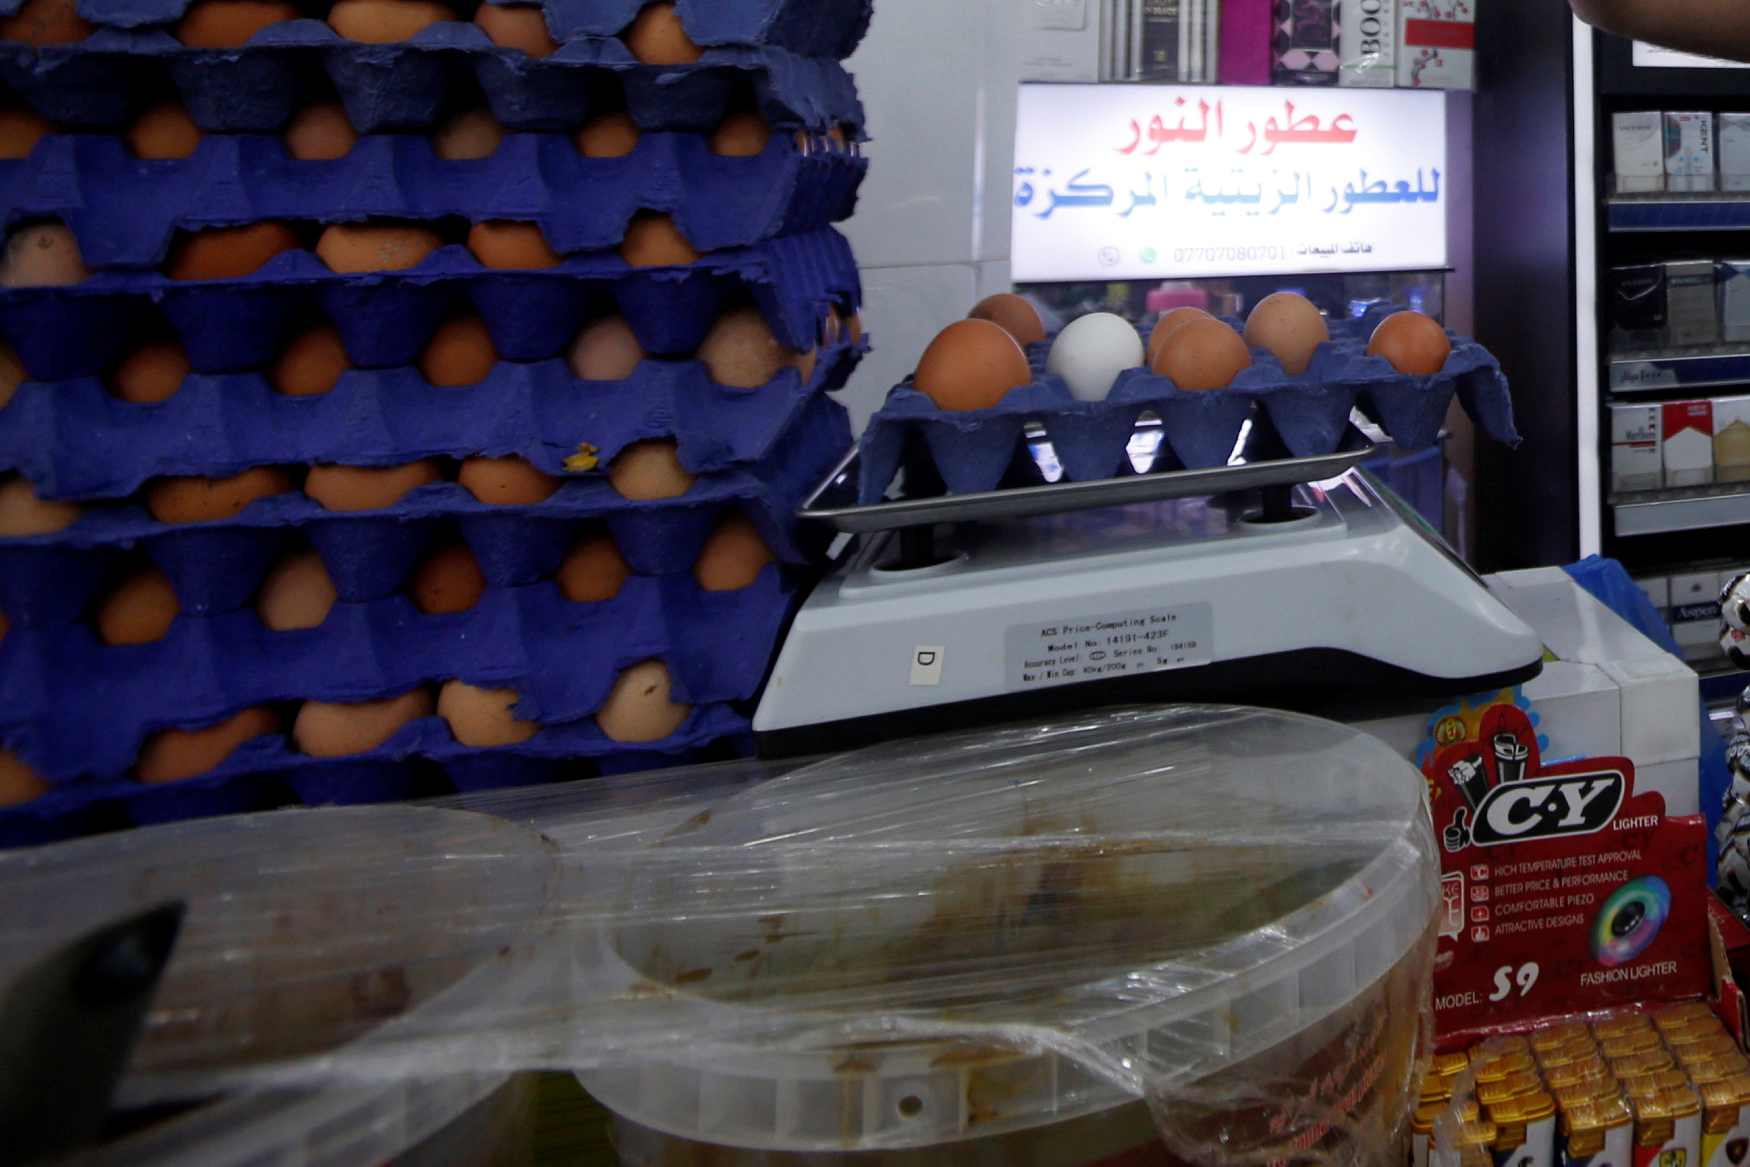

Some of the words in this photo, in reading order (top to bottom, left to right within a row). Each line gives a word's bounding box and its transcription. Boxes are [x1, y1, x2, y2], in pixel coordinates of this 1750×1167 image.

[1114, 97, 1222, 155] النور
[1236, 99, 1358, 155] عطور
[1701, 120, 1709, 154] KENT
[1013, 166, 1168, 220] المركزة
[1184, 167, 1312, 216] الزيتية
[1321, 168, 1440, 214] للعطور
[1174, 244, 1286, 263] 07707080701
[1040, 626, 1058, 637] ACS
[1150, 613, 1177, 624] Scale
[1047, 641, 1079, 652] Model
[1113, 646, 1143, 658] Series
[1612, 815, 1659, 831] LIGHTER
[1494, 864, 1517, 877] HIGH
[1519, 856, 1577, 874] TEMPERATURE
[1579, 854, 1596, 867] TEST
[1597, 849, 1643, 865] APPROVAL
[1494, 883, 1523, 897] BETTER
[1524, 880, 1550, 893] PRICE
[1562, 869, 1629, 888] PERFORMANCE
[1494, 897, 1565, 917] COMFORTABLE
[1567, 893, 1595, 906] PIEZO
[1494, 919, 1545, 936] ATTRACTIVE
[1546, 914, 1585, 929] DESIGNS
[1435, 991, 1483, 1011] MODEL:
[1489, 961, 1540, 1002] S9
[1580, 971, 1629, 987] FASHION
[1630, 960, 1677, 979] LIGHTER
